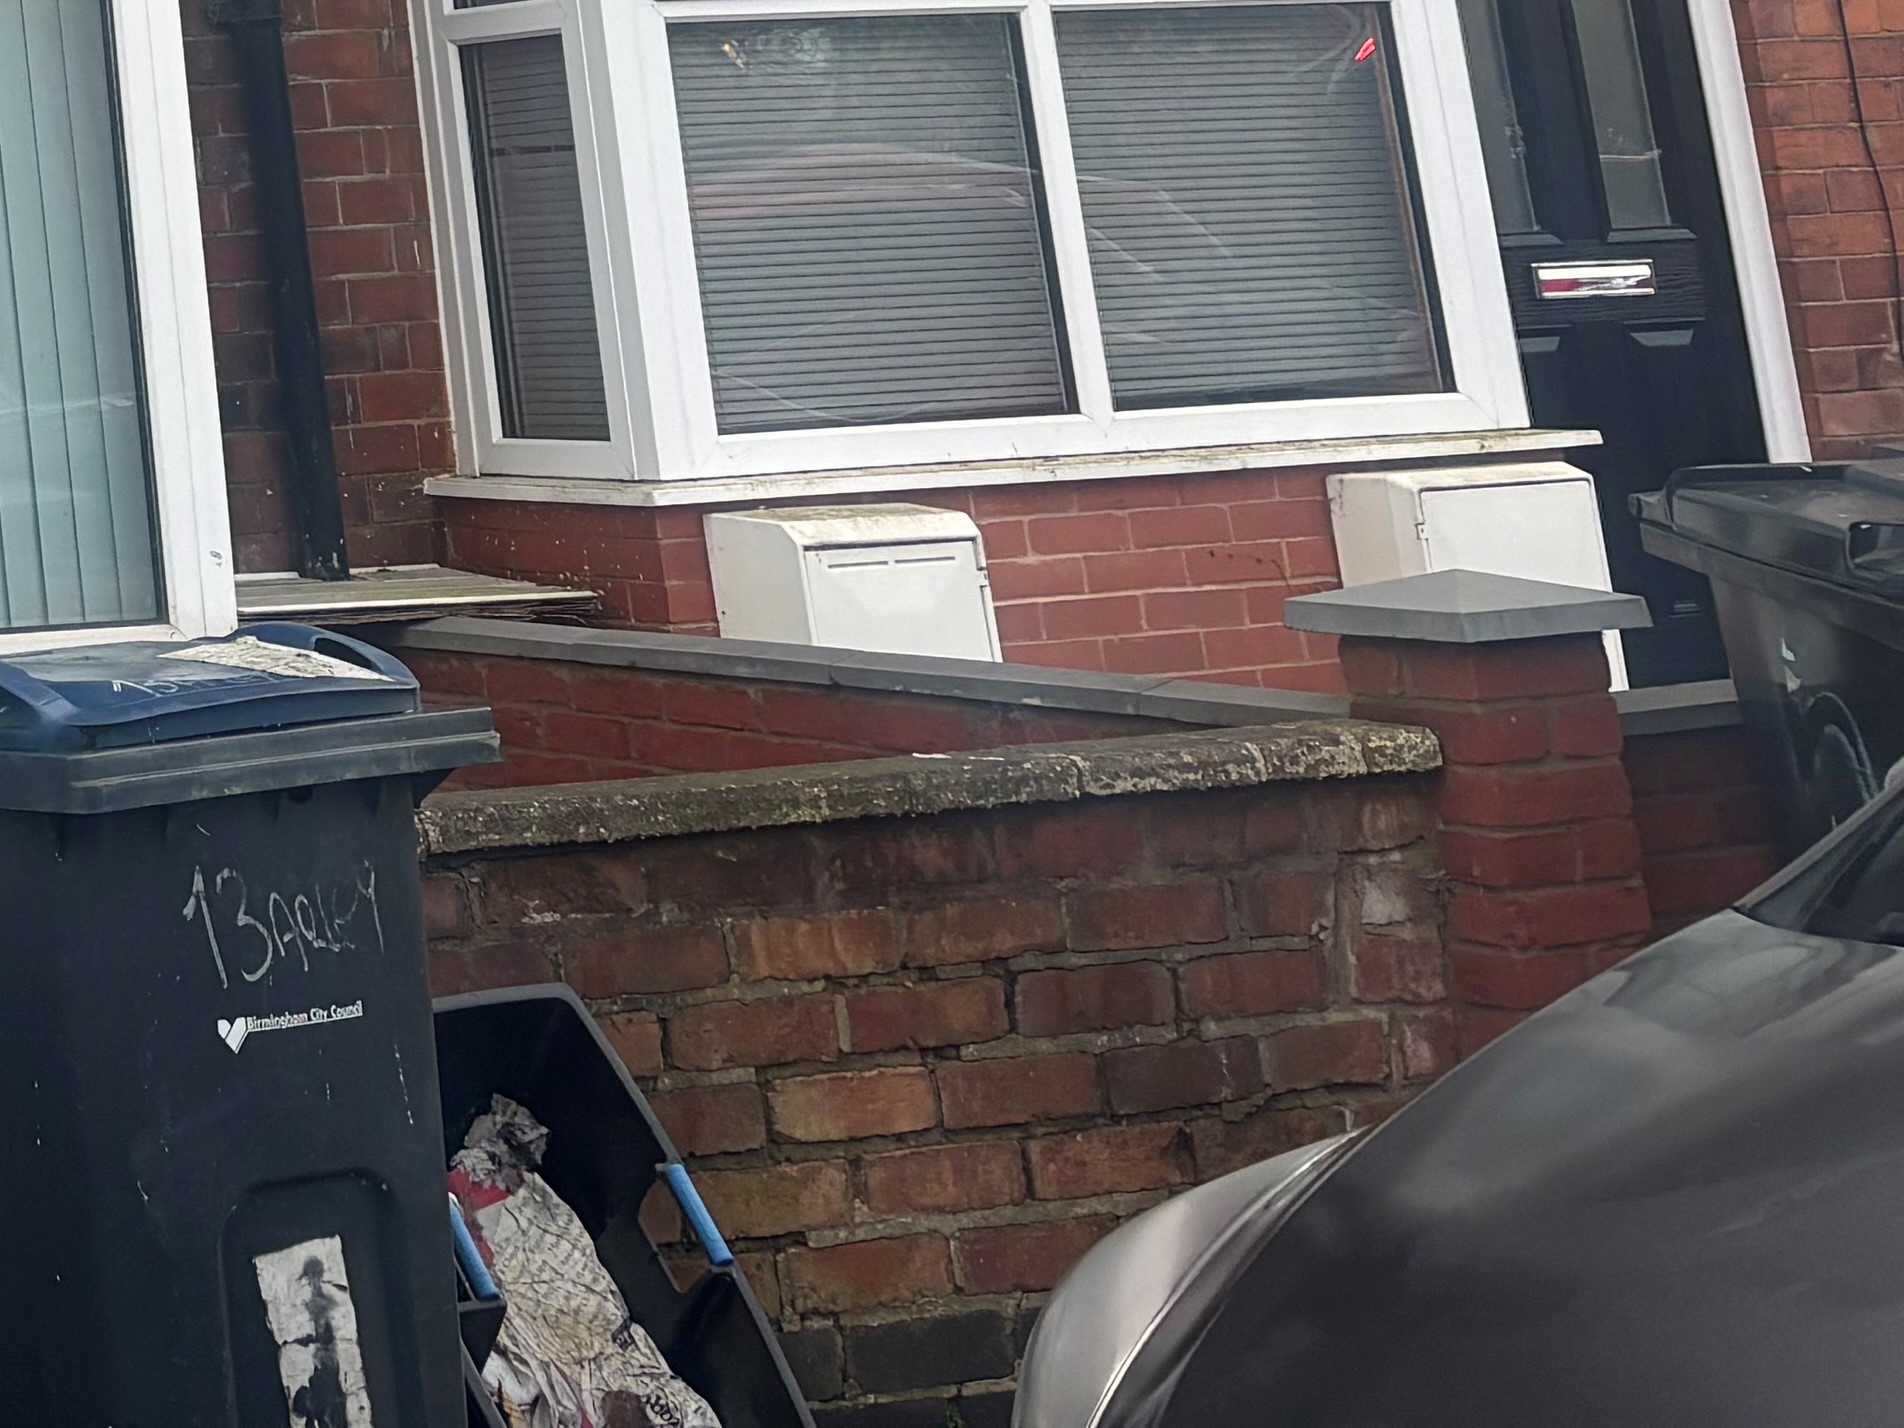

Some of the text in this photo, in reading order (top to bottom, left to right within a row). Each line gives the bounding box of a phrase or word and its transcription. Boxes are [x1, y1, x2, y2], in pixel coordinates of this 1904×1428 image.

[182, 864, 273, 989] 13
[247, 1000, 363, 1029] Birmingham City Council
